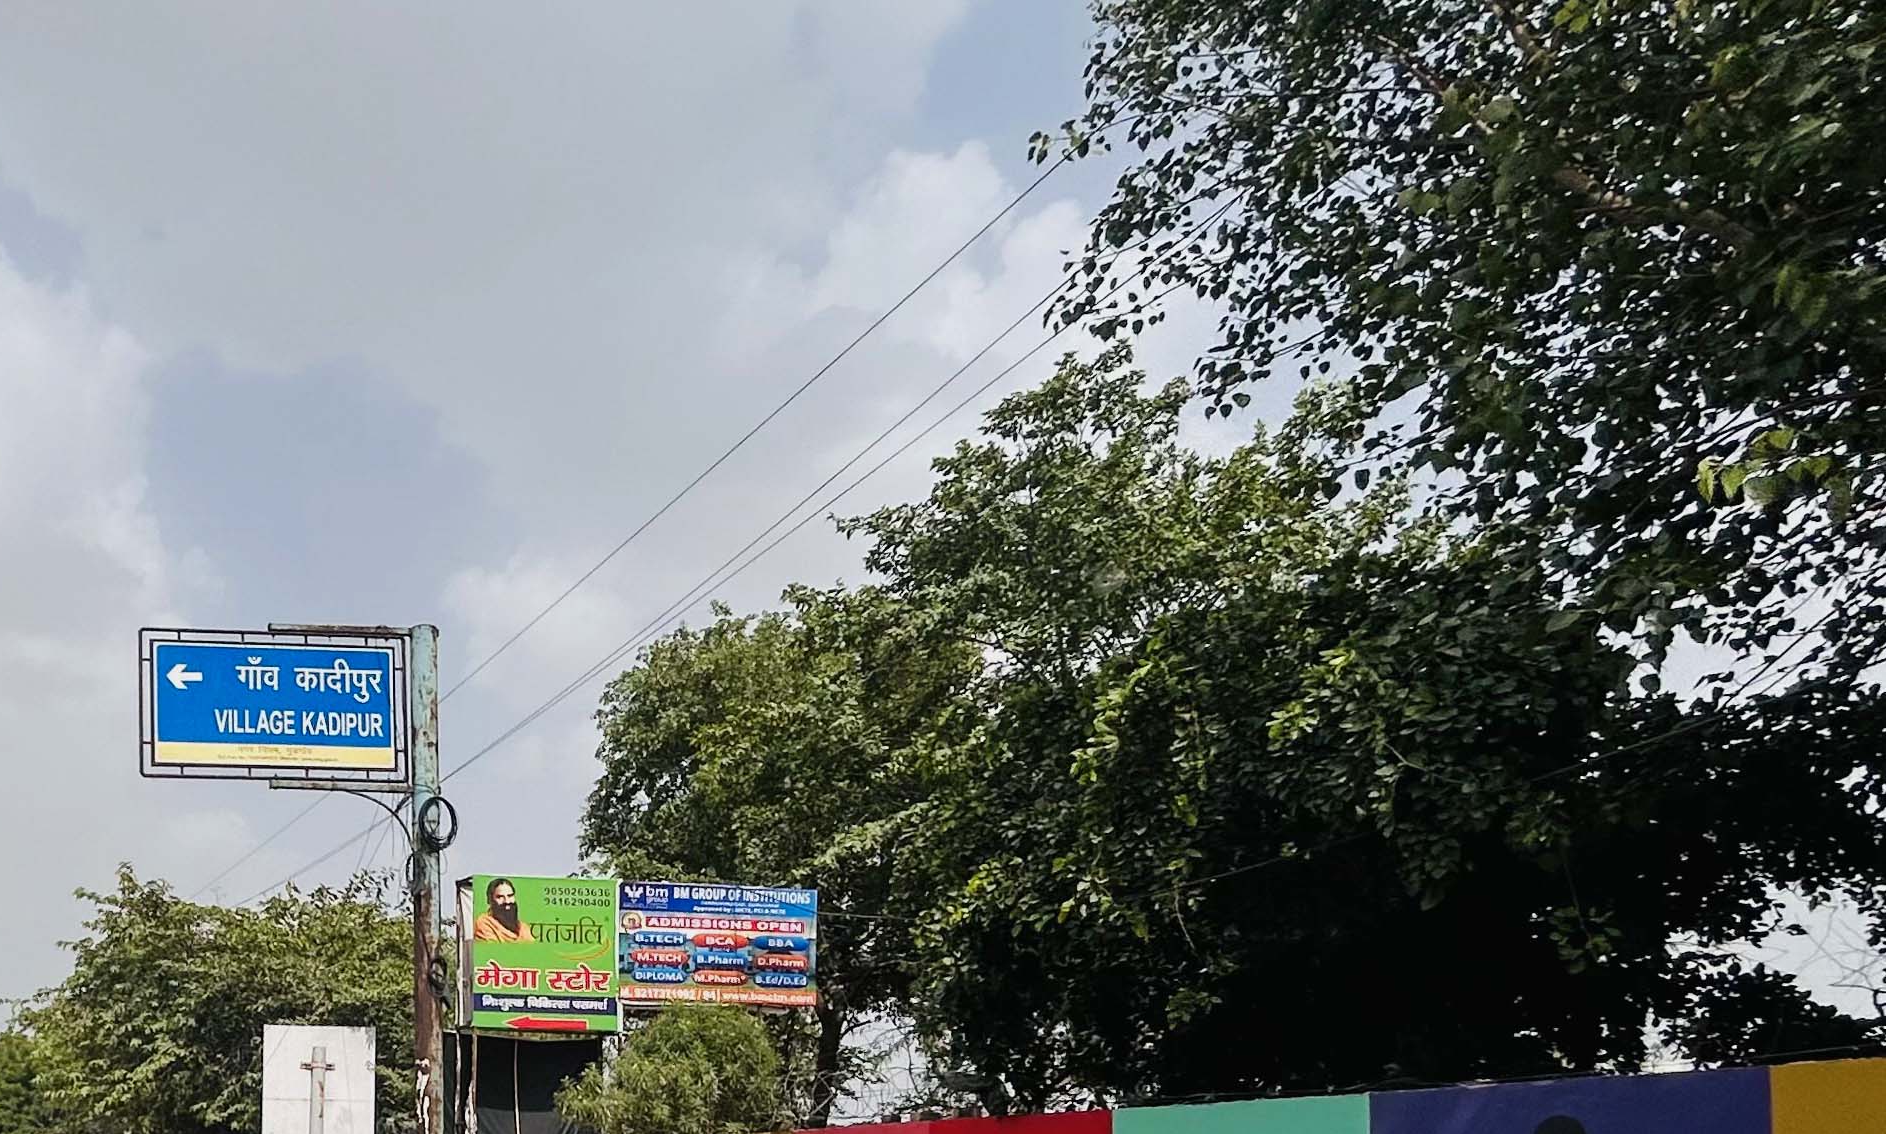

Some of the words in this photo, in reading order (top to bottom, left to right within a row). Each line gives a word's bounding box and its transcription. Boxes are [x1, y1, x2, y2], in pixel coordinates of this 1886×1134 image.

[235, 656, 280, 691] गाँव
[294, 658, 383, 703] कादीपुर
[214, 709, 296, 735] VILLAGE
[301, 711, 384, 737] KADIPUR
[646, 886, 668, 897] bm
[673, 887, 691, 899] BM
[692, 887, 726, 900] GROUP
[728, 889, 741, 901] OF
[743, 889, 811, 905] INSTITUTIONS
[529, 916, 603, 945] पतंजलि
[647, 918, 754, 930] ADMISSIONS
[757, 921, 803, 933] OPEN
[635, 934, 684, 944] B.TECH
[705, 936, 735, 946] BCA
[768, 938, 795, 948] BBA
[636, 952, 682, 962] M.TECH
[696, 954, 745, 966] B.Pharm
[757, 957, 804, 968] D.Pharm
[476, 960, 539, 988] मेगा
[546, 963, 611, 991] स्टोर
[635, 970, 684, 981] DIPLOMA
[755, 975, 807, 987] B.Ed/D.Ed
